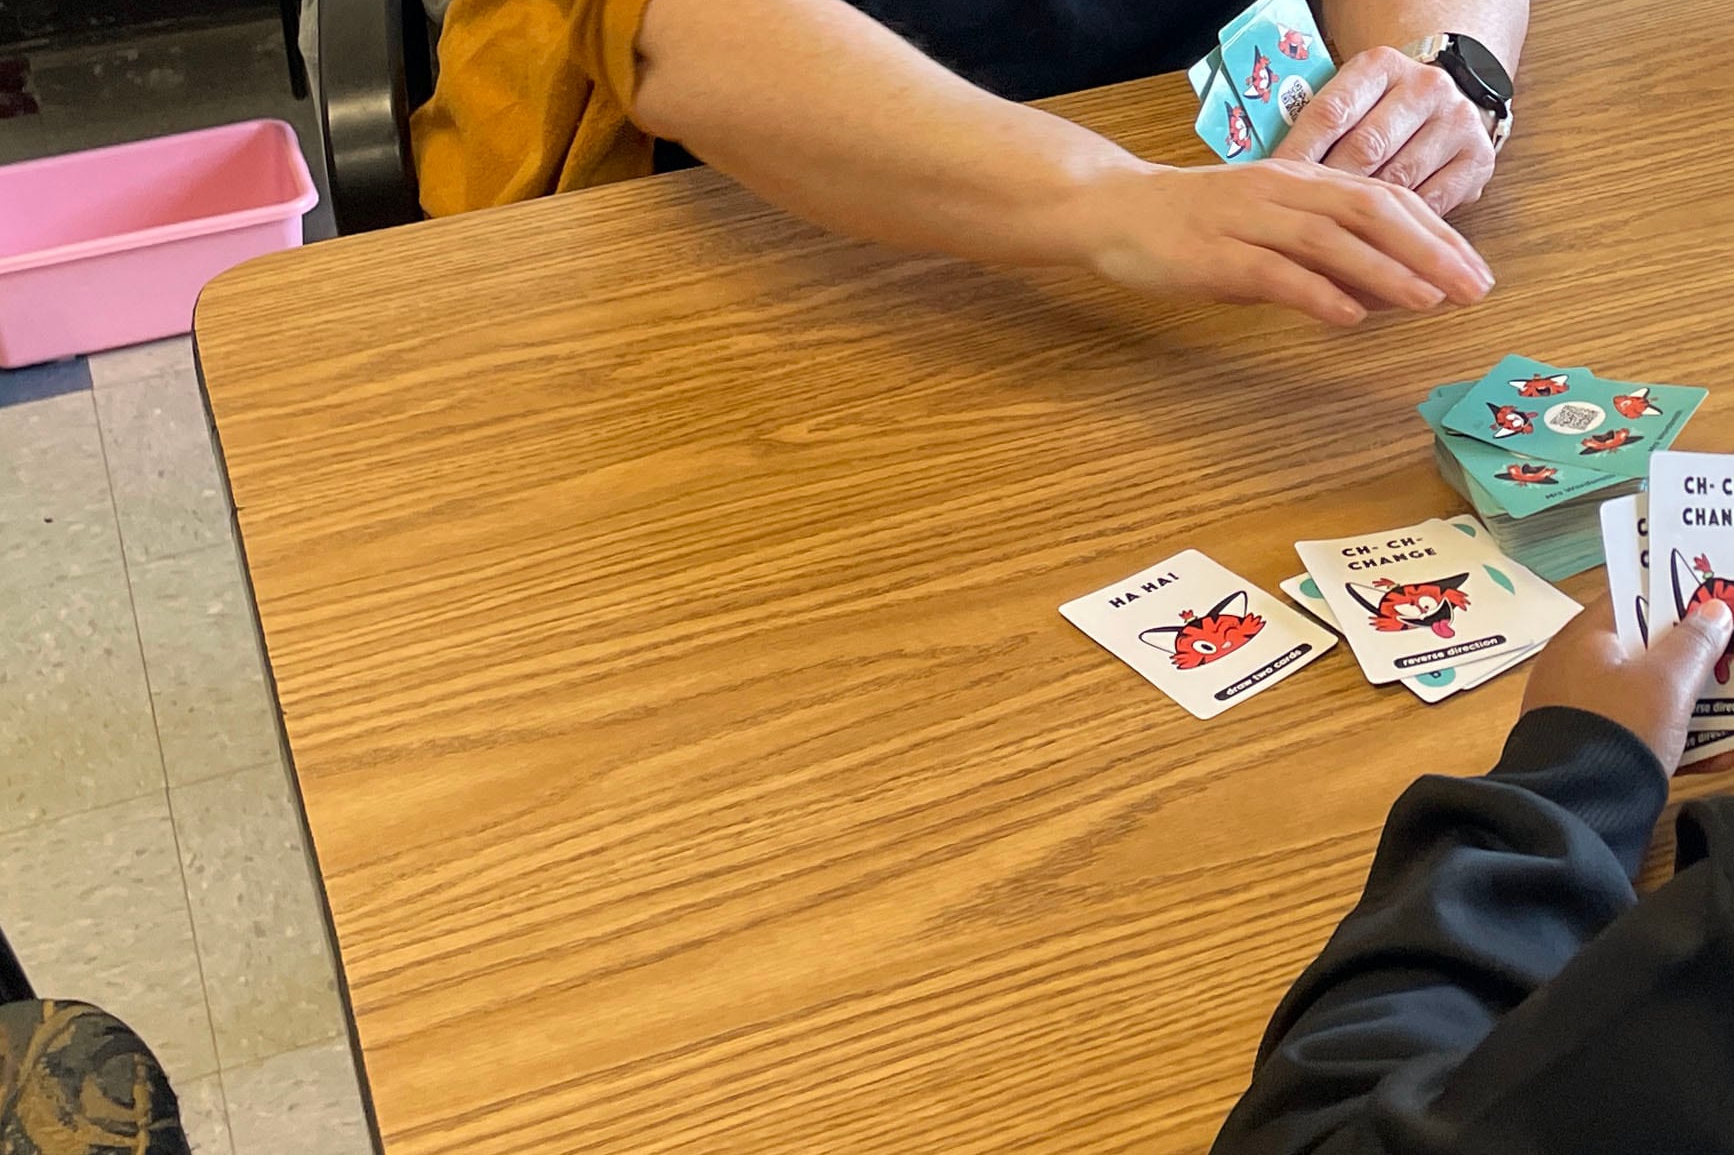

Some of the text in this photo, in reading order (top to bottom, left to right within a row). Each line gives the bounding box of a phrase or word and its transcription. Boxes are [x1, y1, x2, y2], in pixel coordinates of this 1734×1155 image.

[1348, 547, 1437, 571] CHANGE
[1108, 572, 1179, 609] HA HA!
[1403, 637, 1498, 667] reverse direction
[1226, 648, 1302, 696] draw two cards
